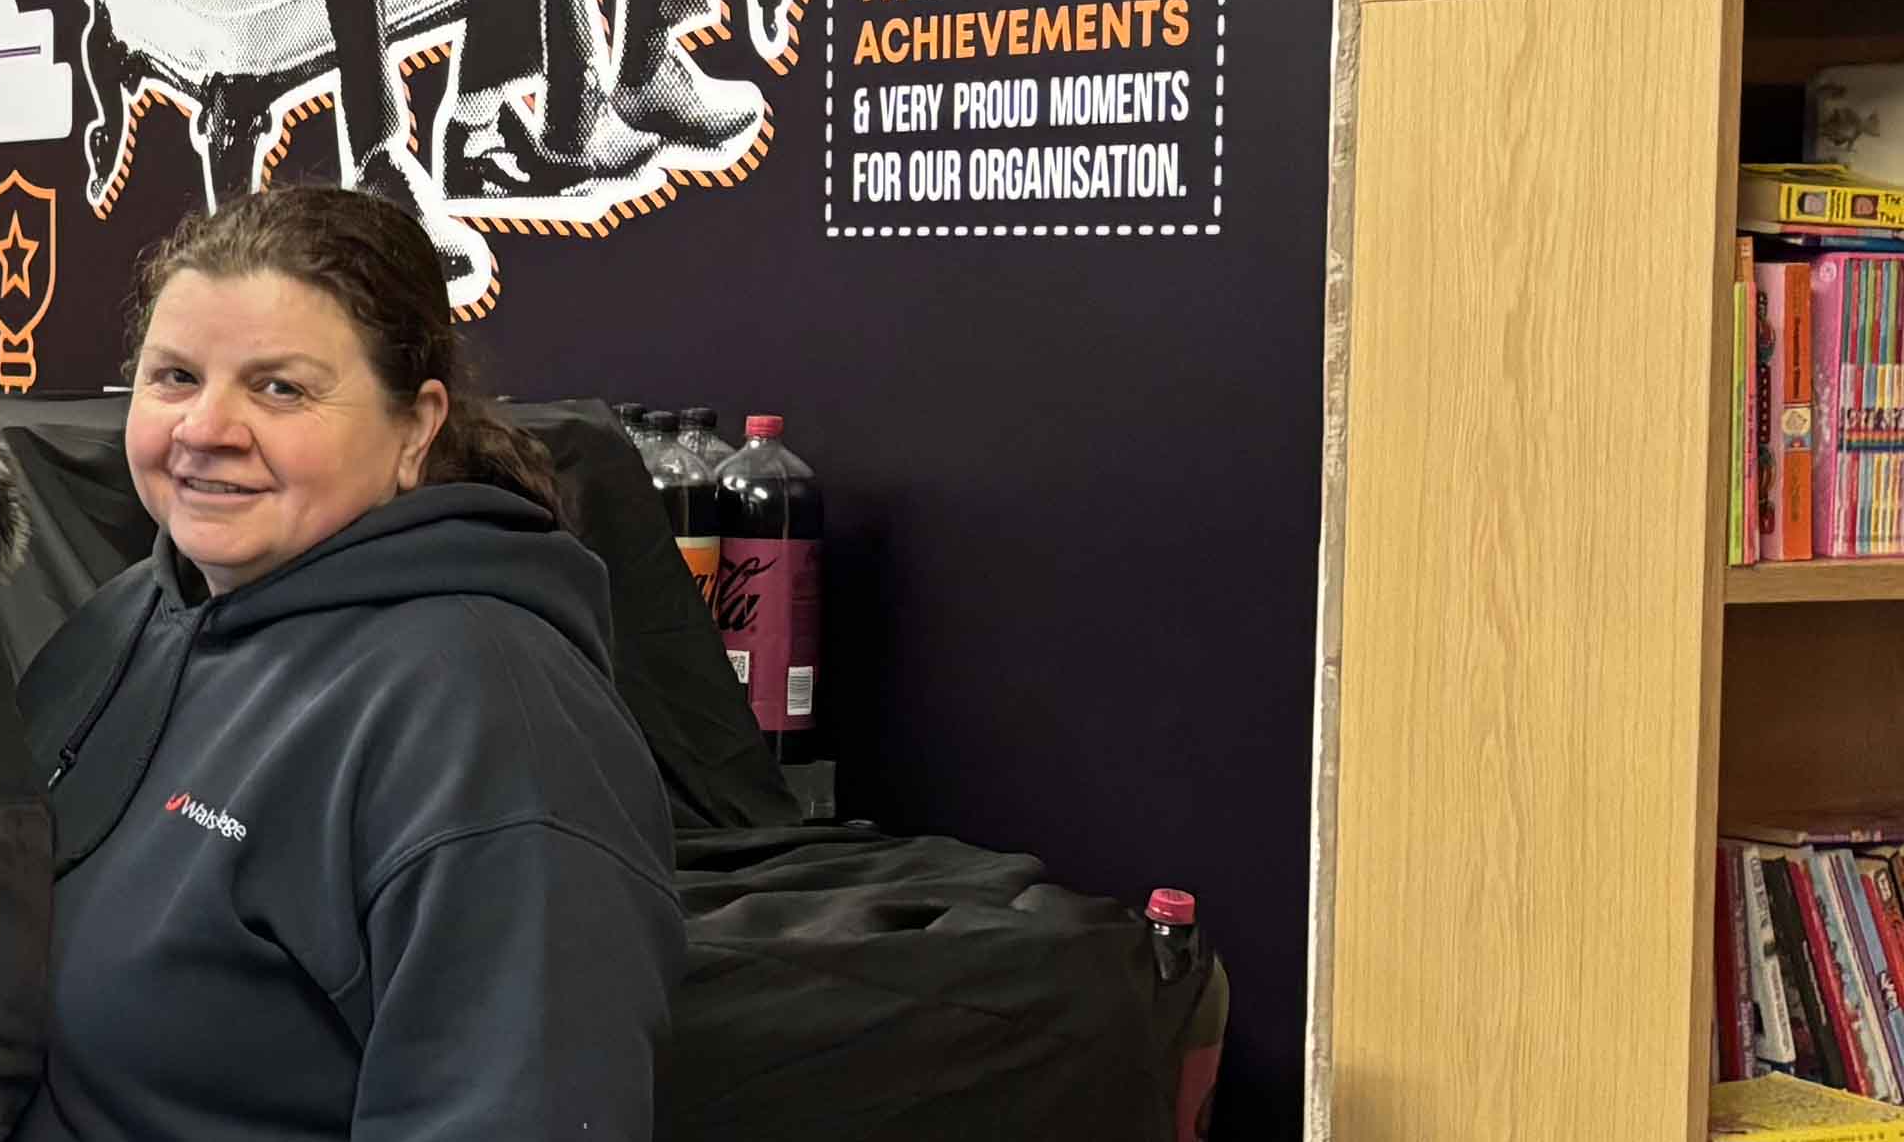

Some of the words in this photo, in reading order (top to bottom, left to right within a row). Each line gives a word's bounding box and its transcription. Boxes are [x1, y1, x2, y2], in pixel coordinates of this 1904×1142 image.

[854, 88, 870, 134] &
[880, 83, 943, 132] VERY
[954, 79, 1038, 130] PROUD
[1050, 70, 1189, 126] MOMENTS
[853, 152, 901, 202] FOR
[909, 150, 961, 201] OUR
[969, 143, 1186, 200] ORGANISATION.
